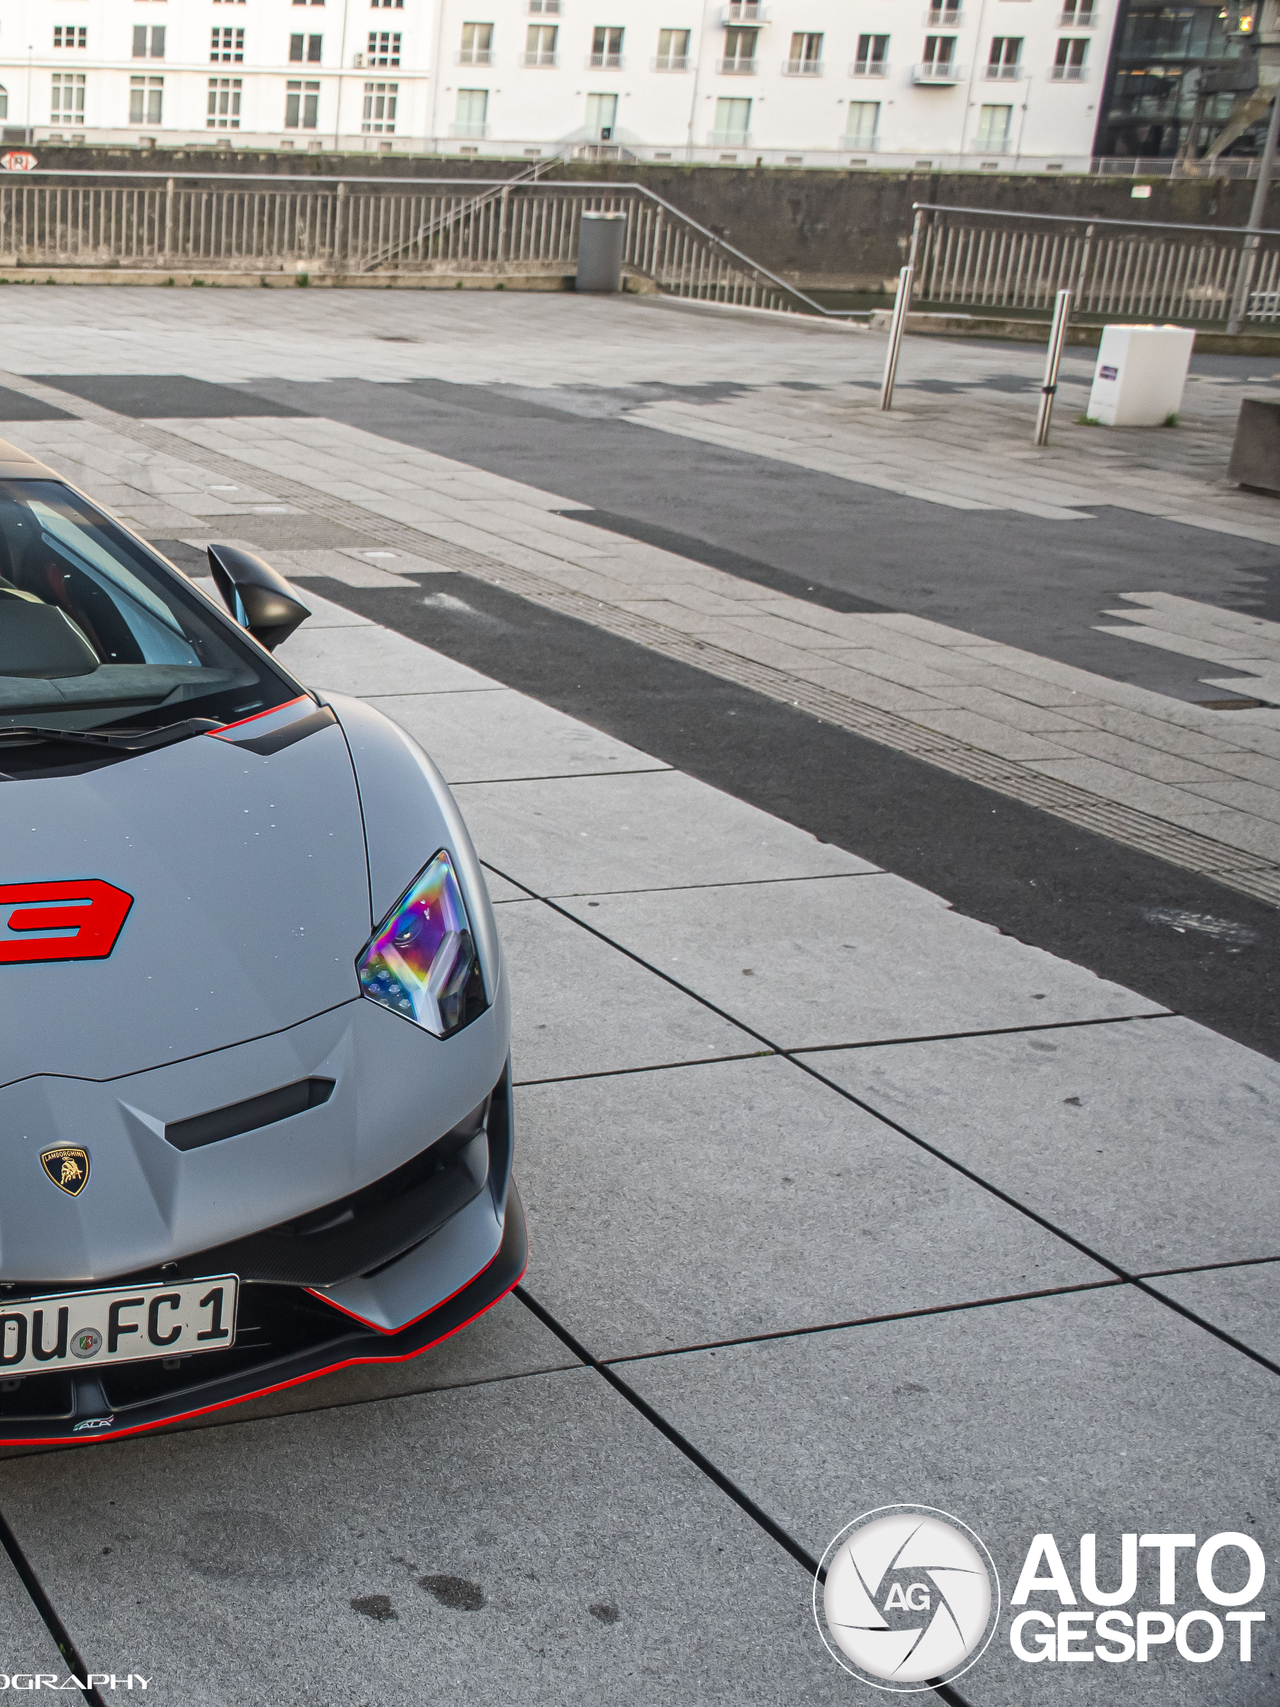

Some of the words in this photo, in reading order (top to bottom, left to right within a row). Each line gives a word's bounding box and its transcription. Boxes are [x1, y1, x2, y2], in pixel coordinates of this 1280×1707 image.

[45, 1150, 84, 1162] LAMBORGHINI
[107, 1293, 182, 1353] FC
[197, 1287, 229, 1341] 1
